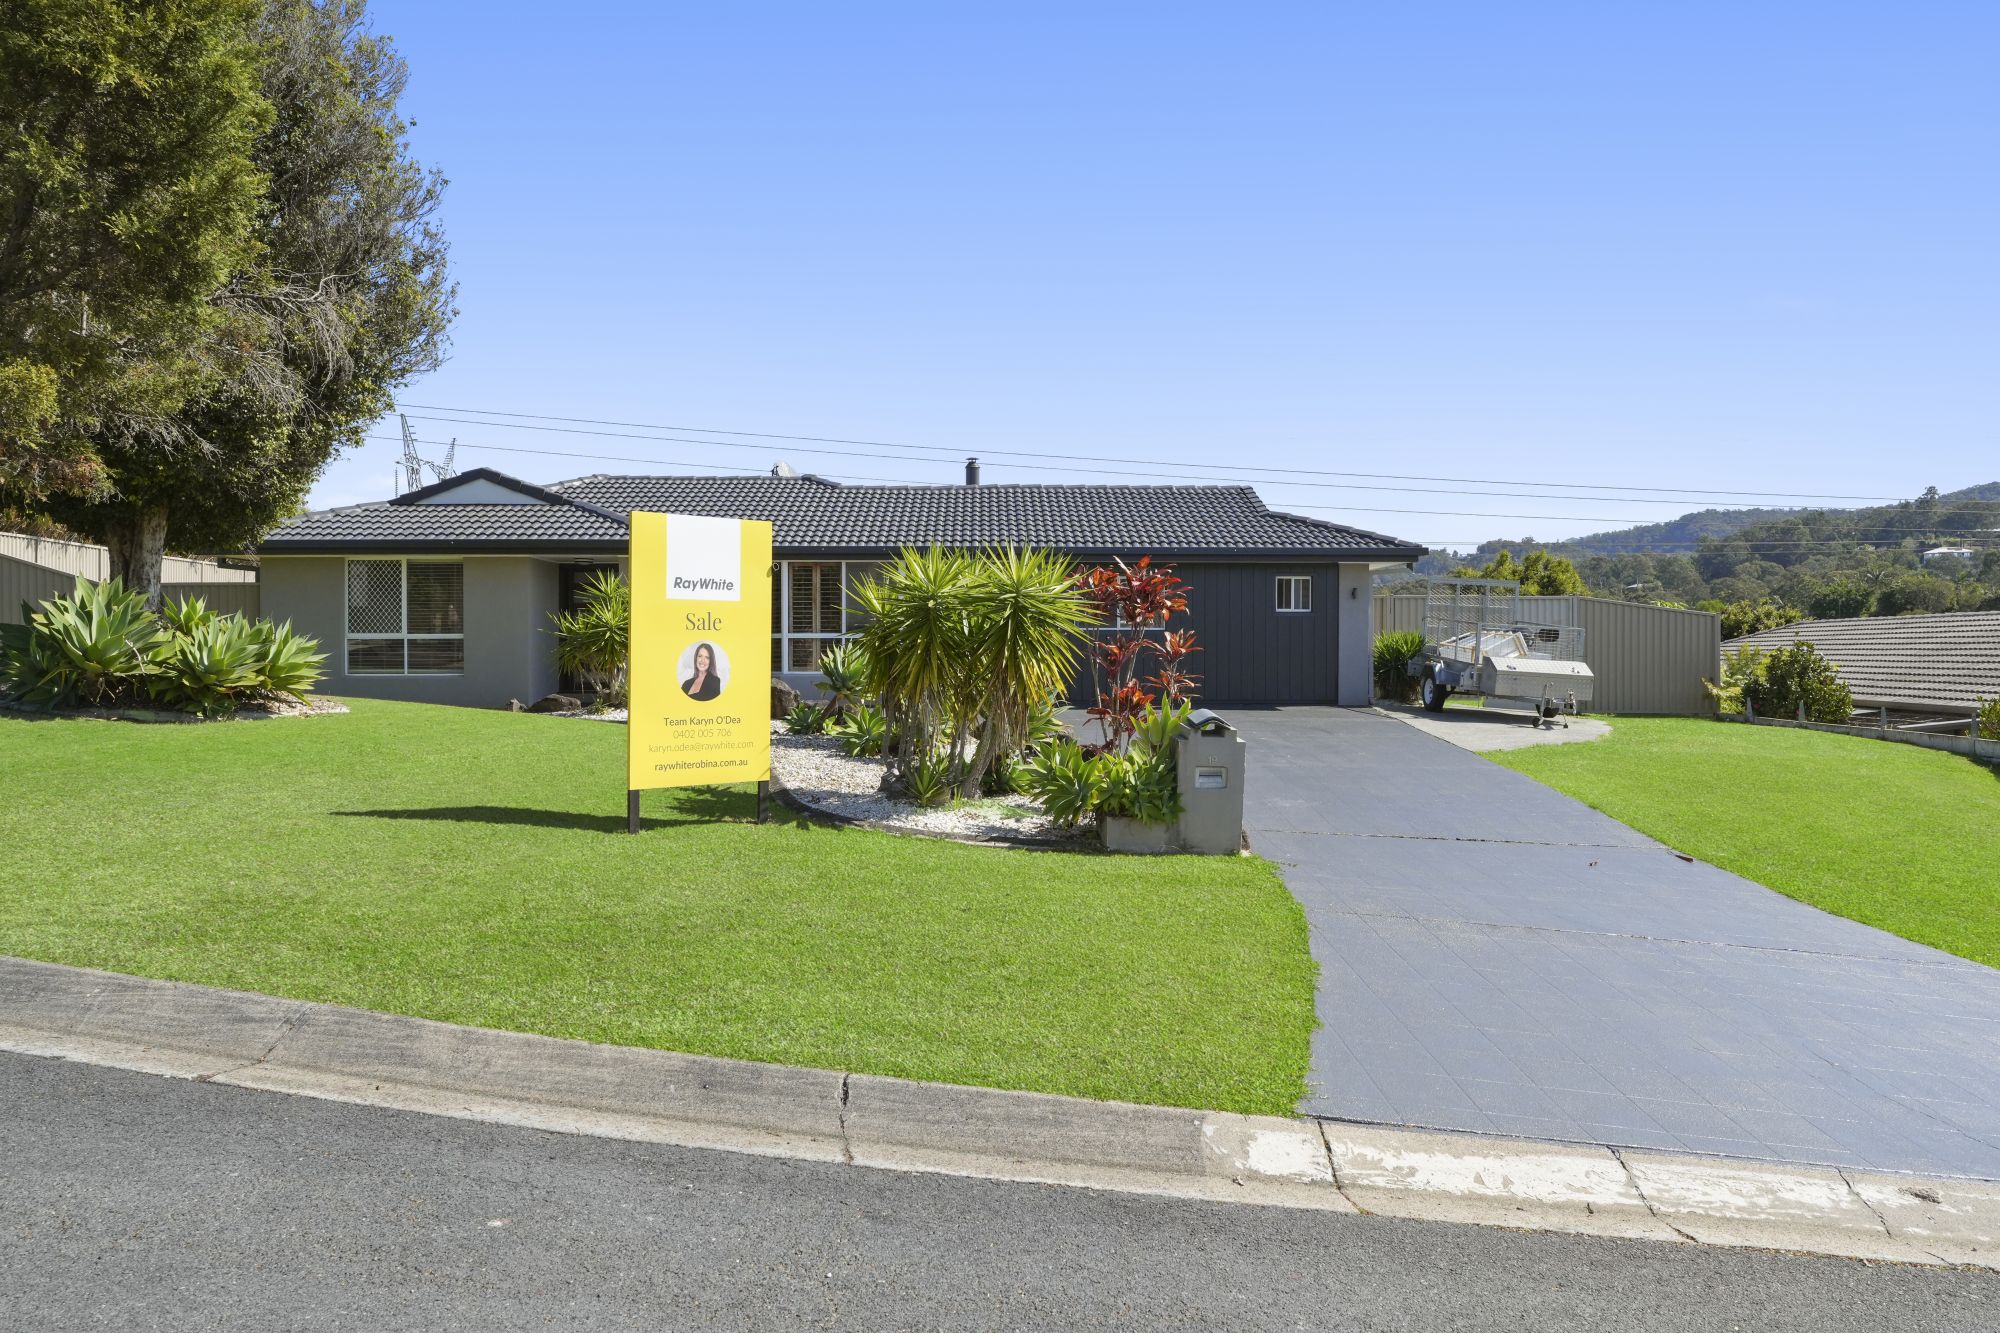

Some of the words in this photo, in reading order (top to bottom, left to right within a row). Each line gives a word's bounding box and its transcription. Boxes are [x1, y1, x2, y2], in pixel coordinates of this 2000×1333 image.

[685, 611, 722, 631] Sale
[664, 717, 688, 726] Team
[689, 717, 714, 727] Karyn
[715, 715, 741, 725] O'Dea
[673, 729, 695, 739] 0402
[697, 729, 714, 738] 005
[716, 728, 732, 737] 706
[648, 741, 754, 754] karyn.odea@raywhite.com
[654, 759, 748, 772] raywhiterobina.com.au
